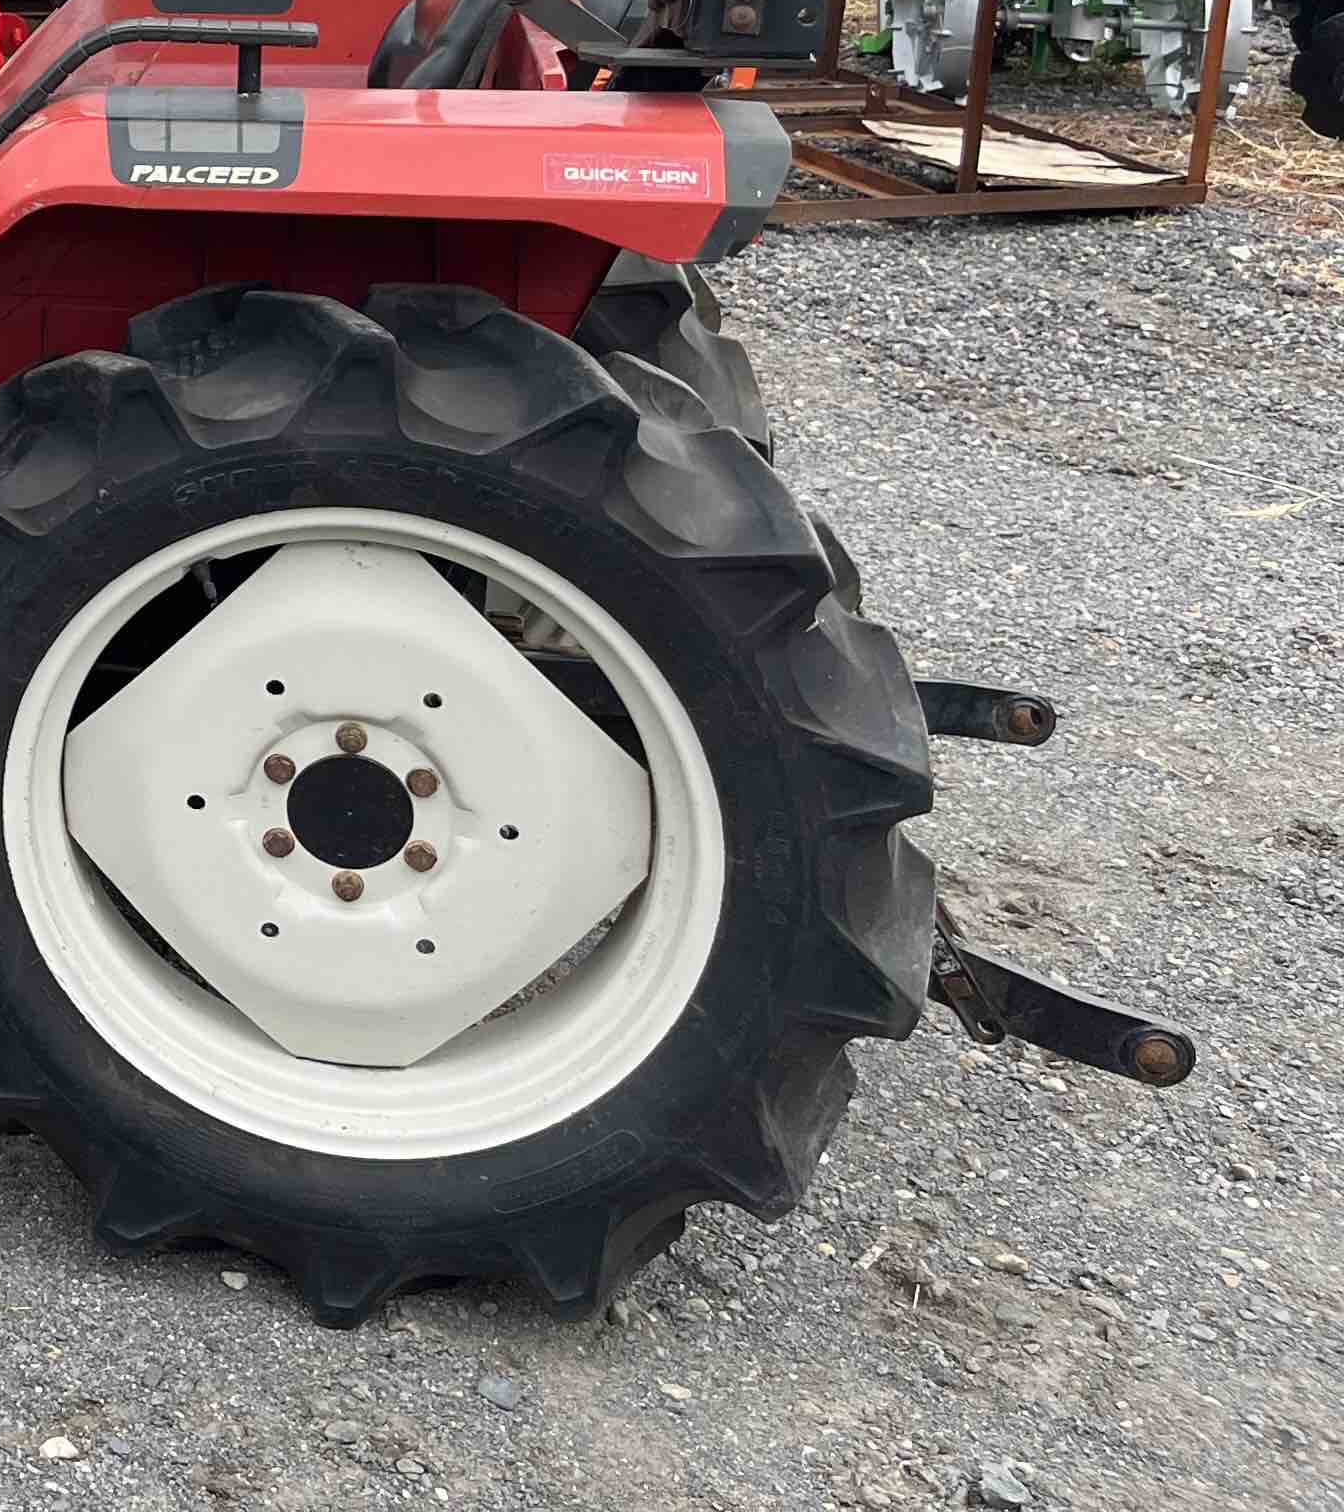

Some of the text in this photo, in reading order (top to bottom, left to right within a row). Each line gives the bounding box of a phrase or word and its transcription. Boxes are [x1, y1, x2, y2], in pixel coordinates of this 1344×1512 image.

[129, 164, 280, 185] PALCEED
[564, 167, 698, 184] QUICK TURN
